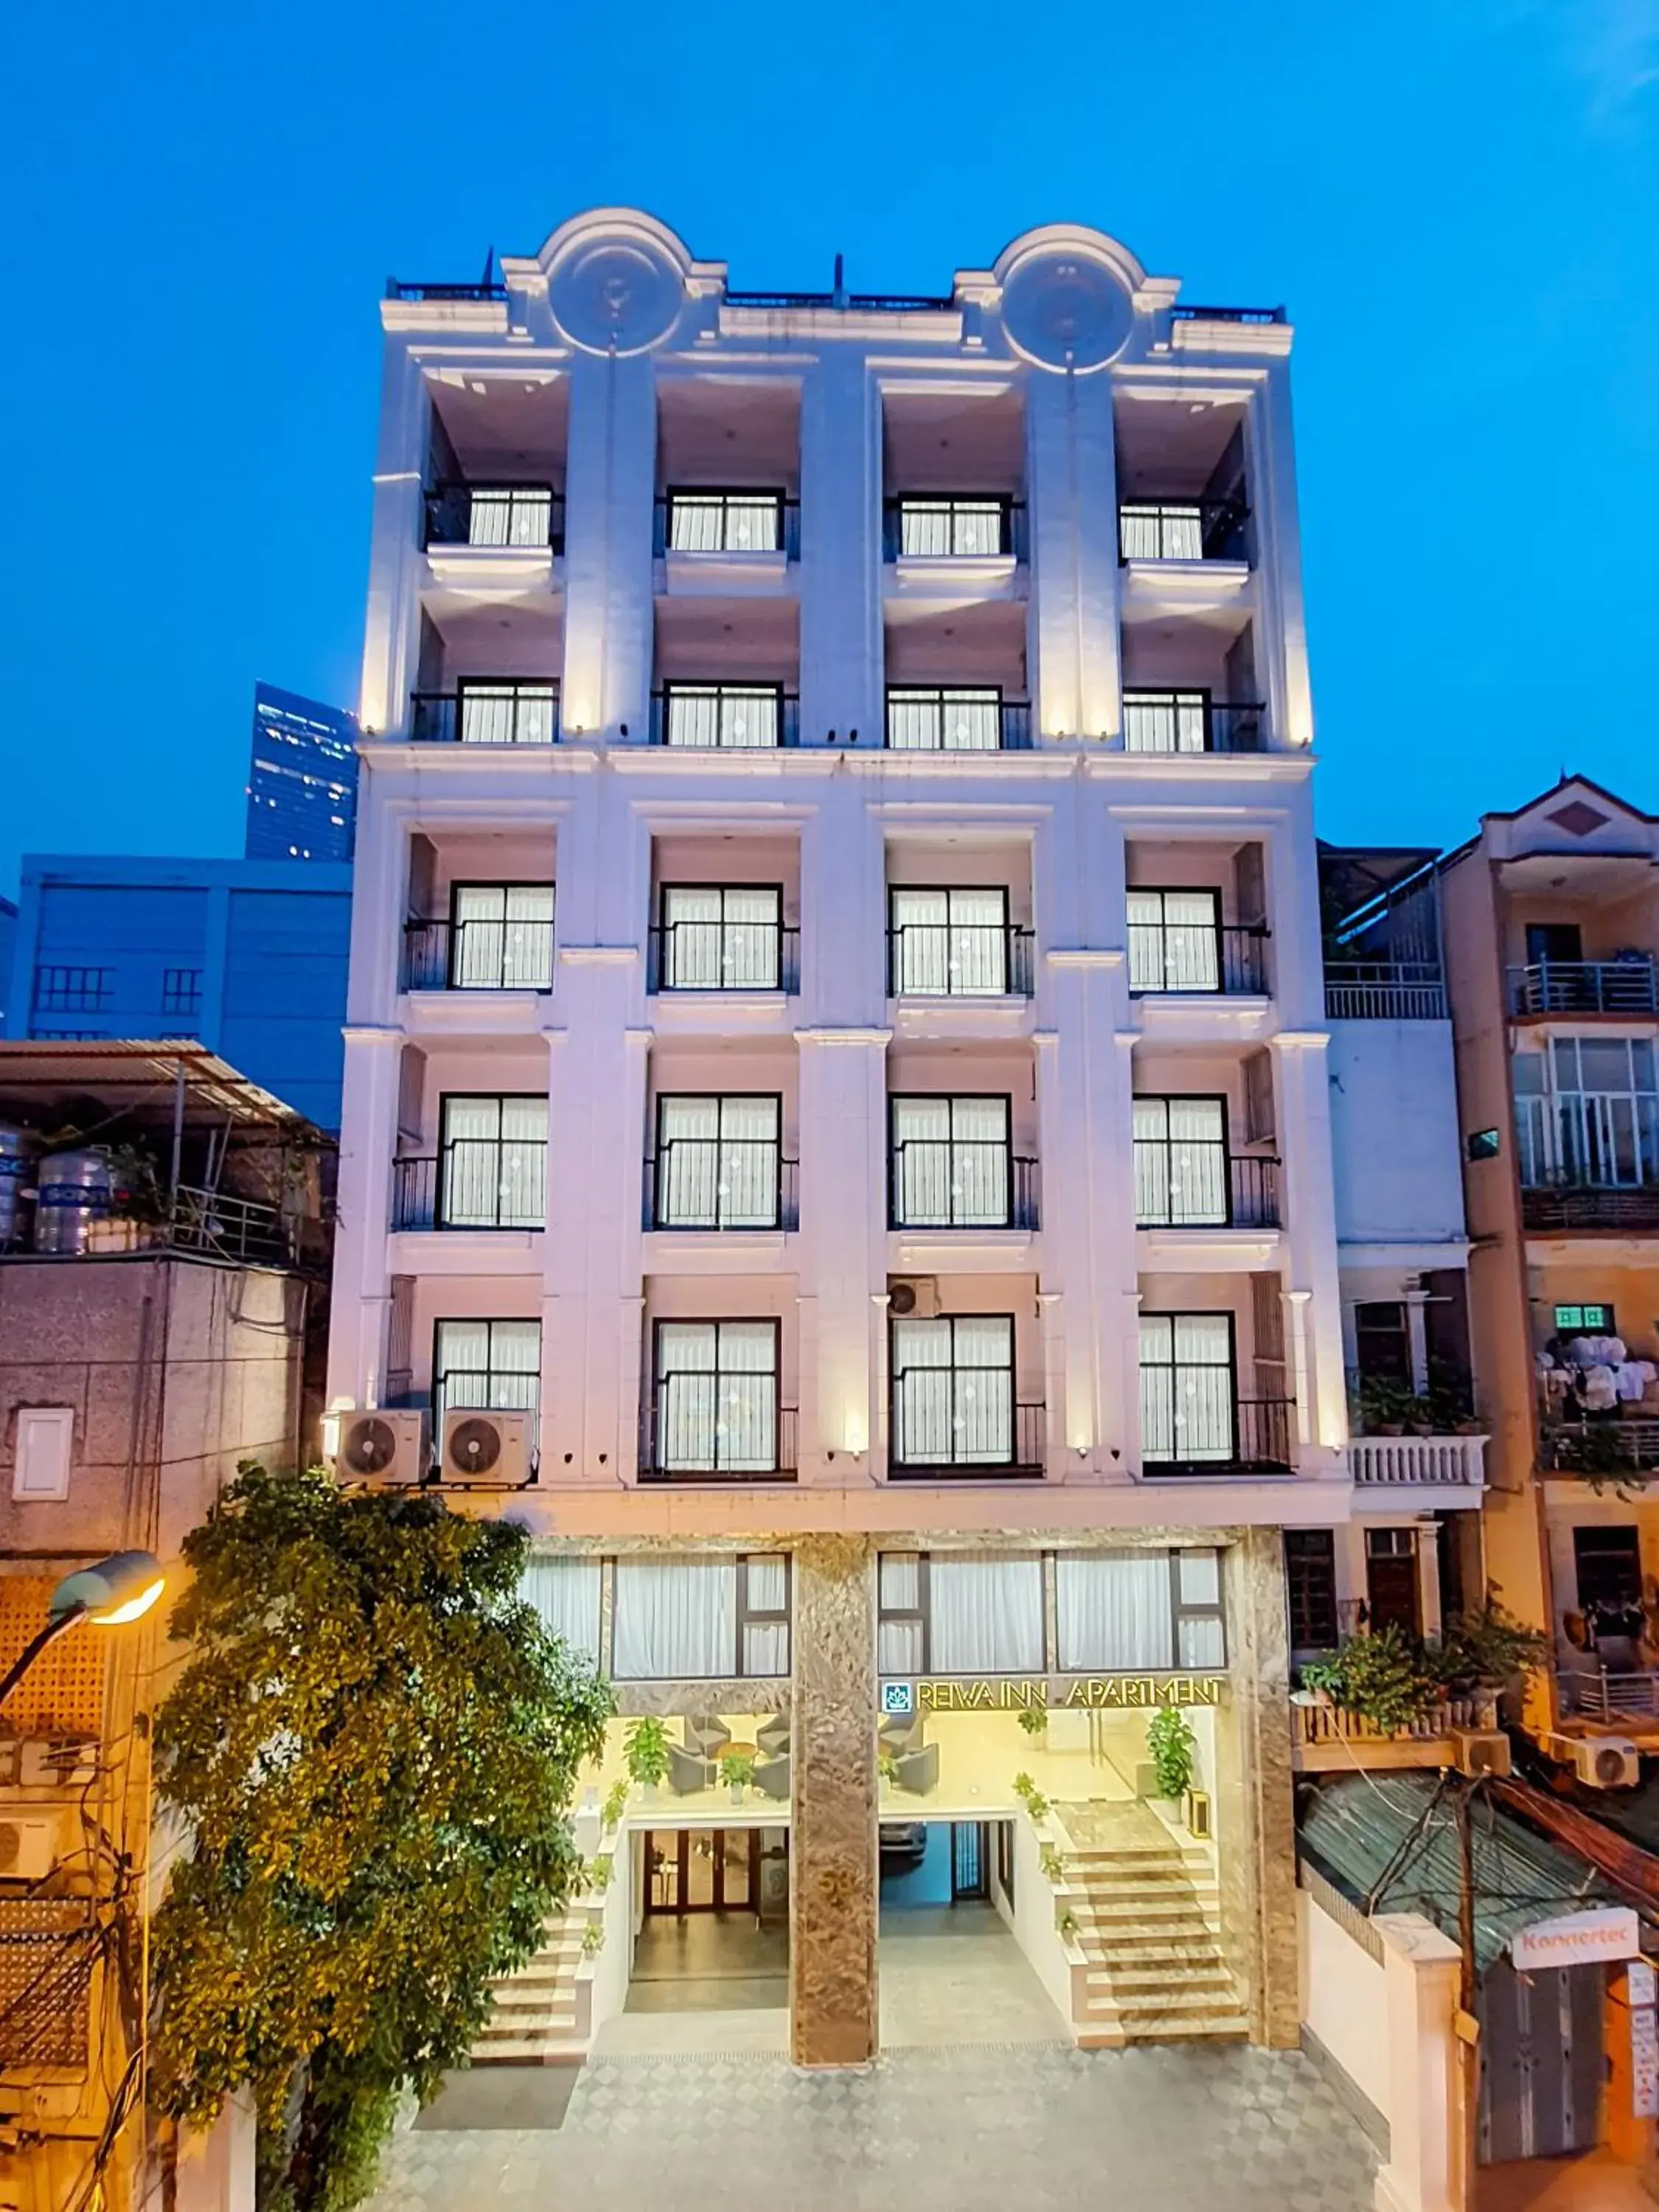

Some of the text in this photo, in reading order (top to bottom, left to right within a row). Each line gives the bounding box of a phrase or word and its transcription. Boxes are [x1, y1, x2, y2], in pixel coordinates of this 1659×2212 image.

[917, 1677, 1226, 1709] REIWA INN APARTMENT
